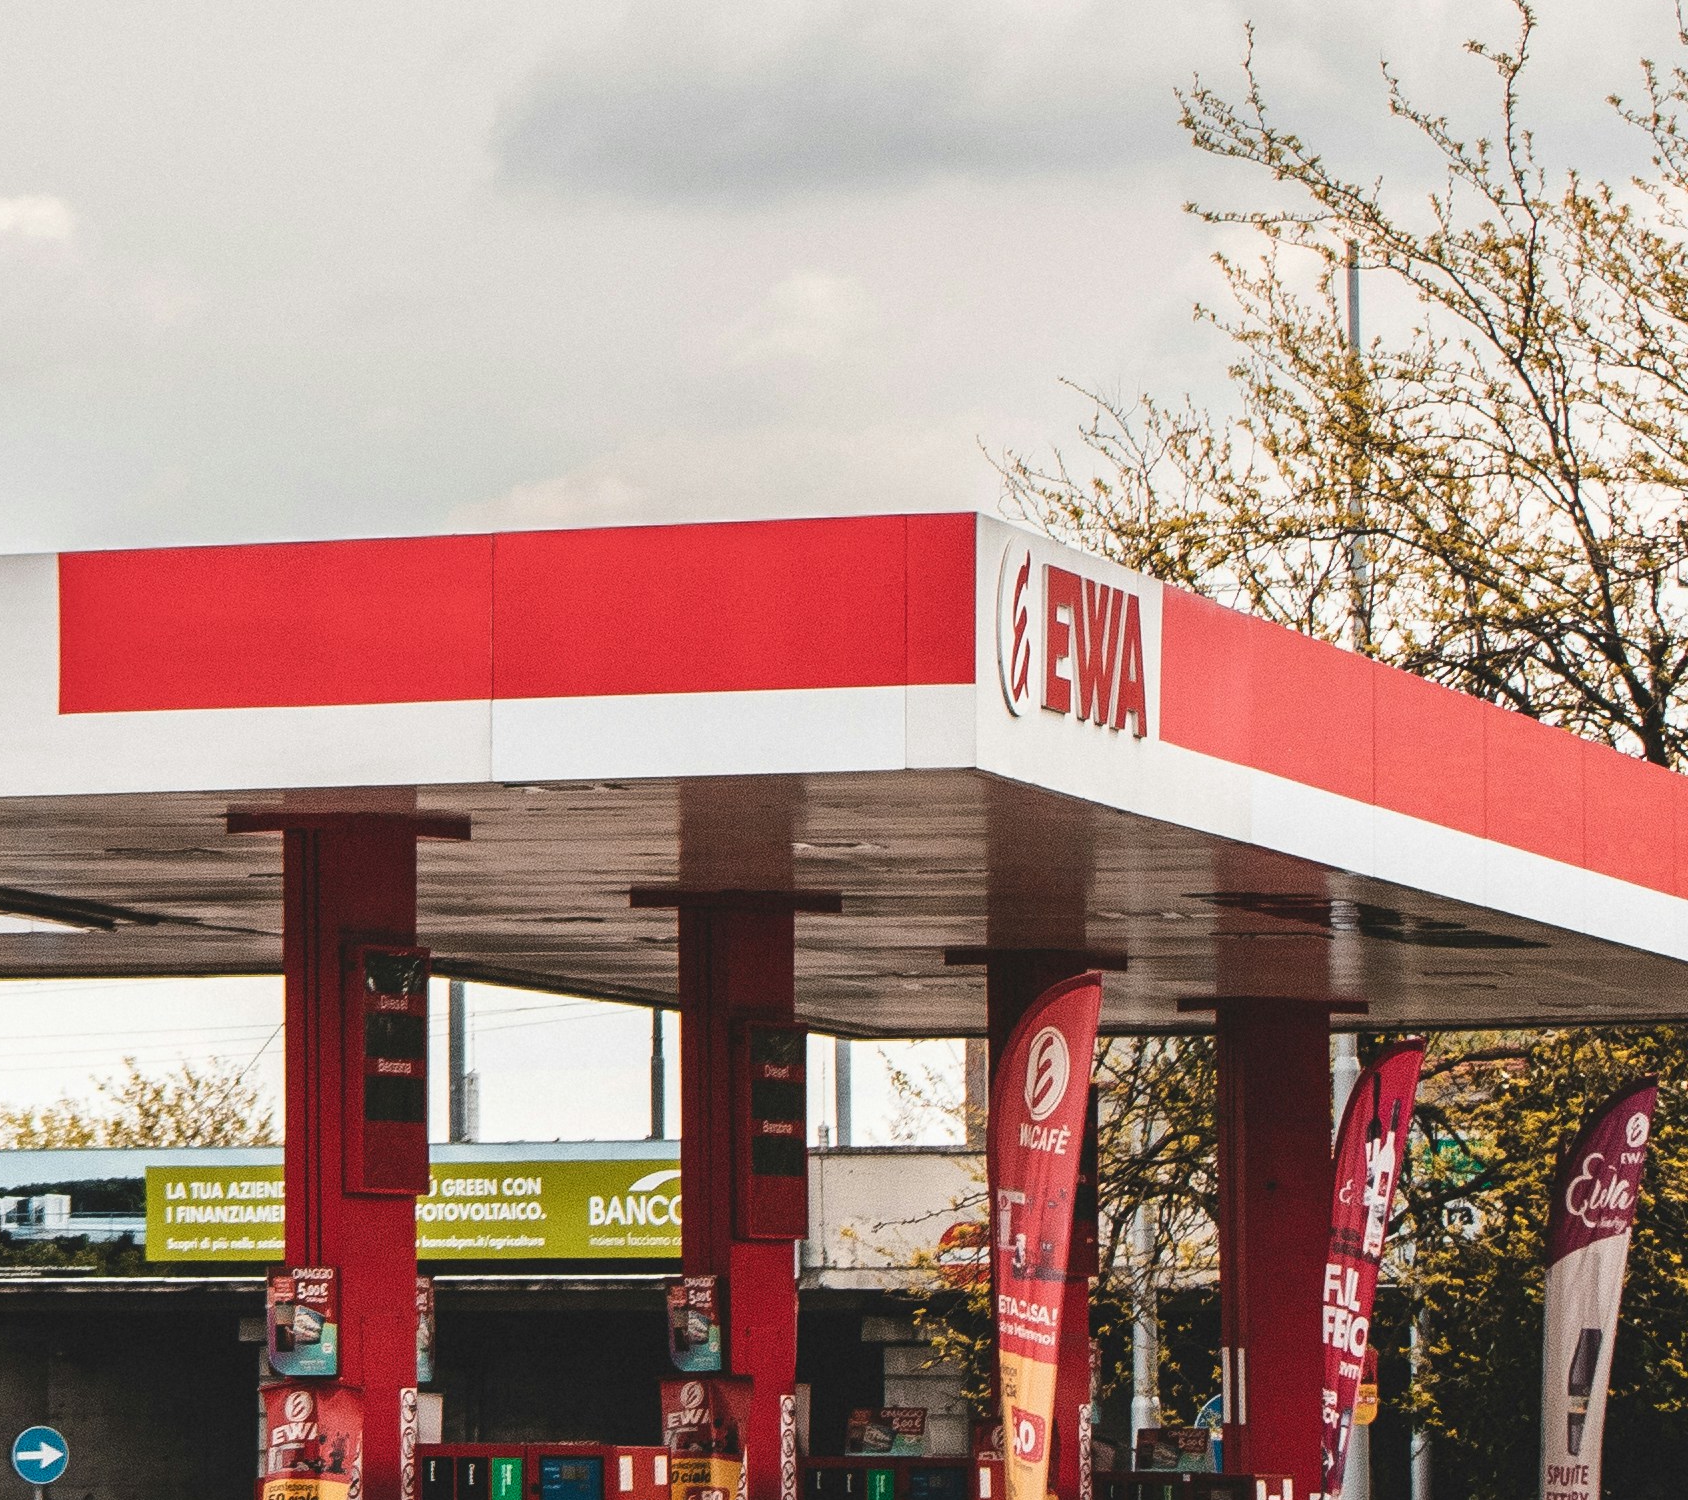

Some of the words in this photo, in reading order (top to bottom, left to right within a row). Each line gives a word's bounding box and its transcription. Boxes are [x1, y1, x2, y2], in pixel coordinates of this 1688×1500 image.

[1041, 564, 1148, 738] EWA
[380, 995, 408, 1011] Diesel
[166, 1181, 186, 1200] LA
[190, 1180, 223, 1200] TUA
[441, 1178, 497, 1198] GREEN
[502, 1177, 542, 1196] CON
[166, 1205, 172, 1224] I
[292, 1267, 334, 1280] OMAGGIO
